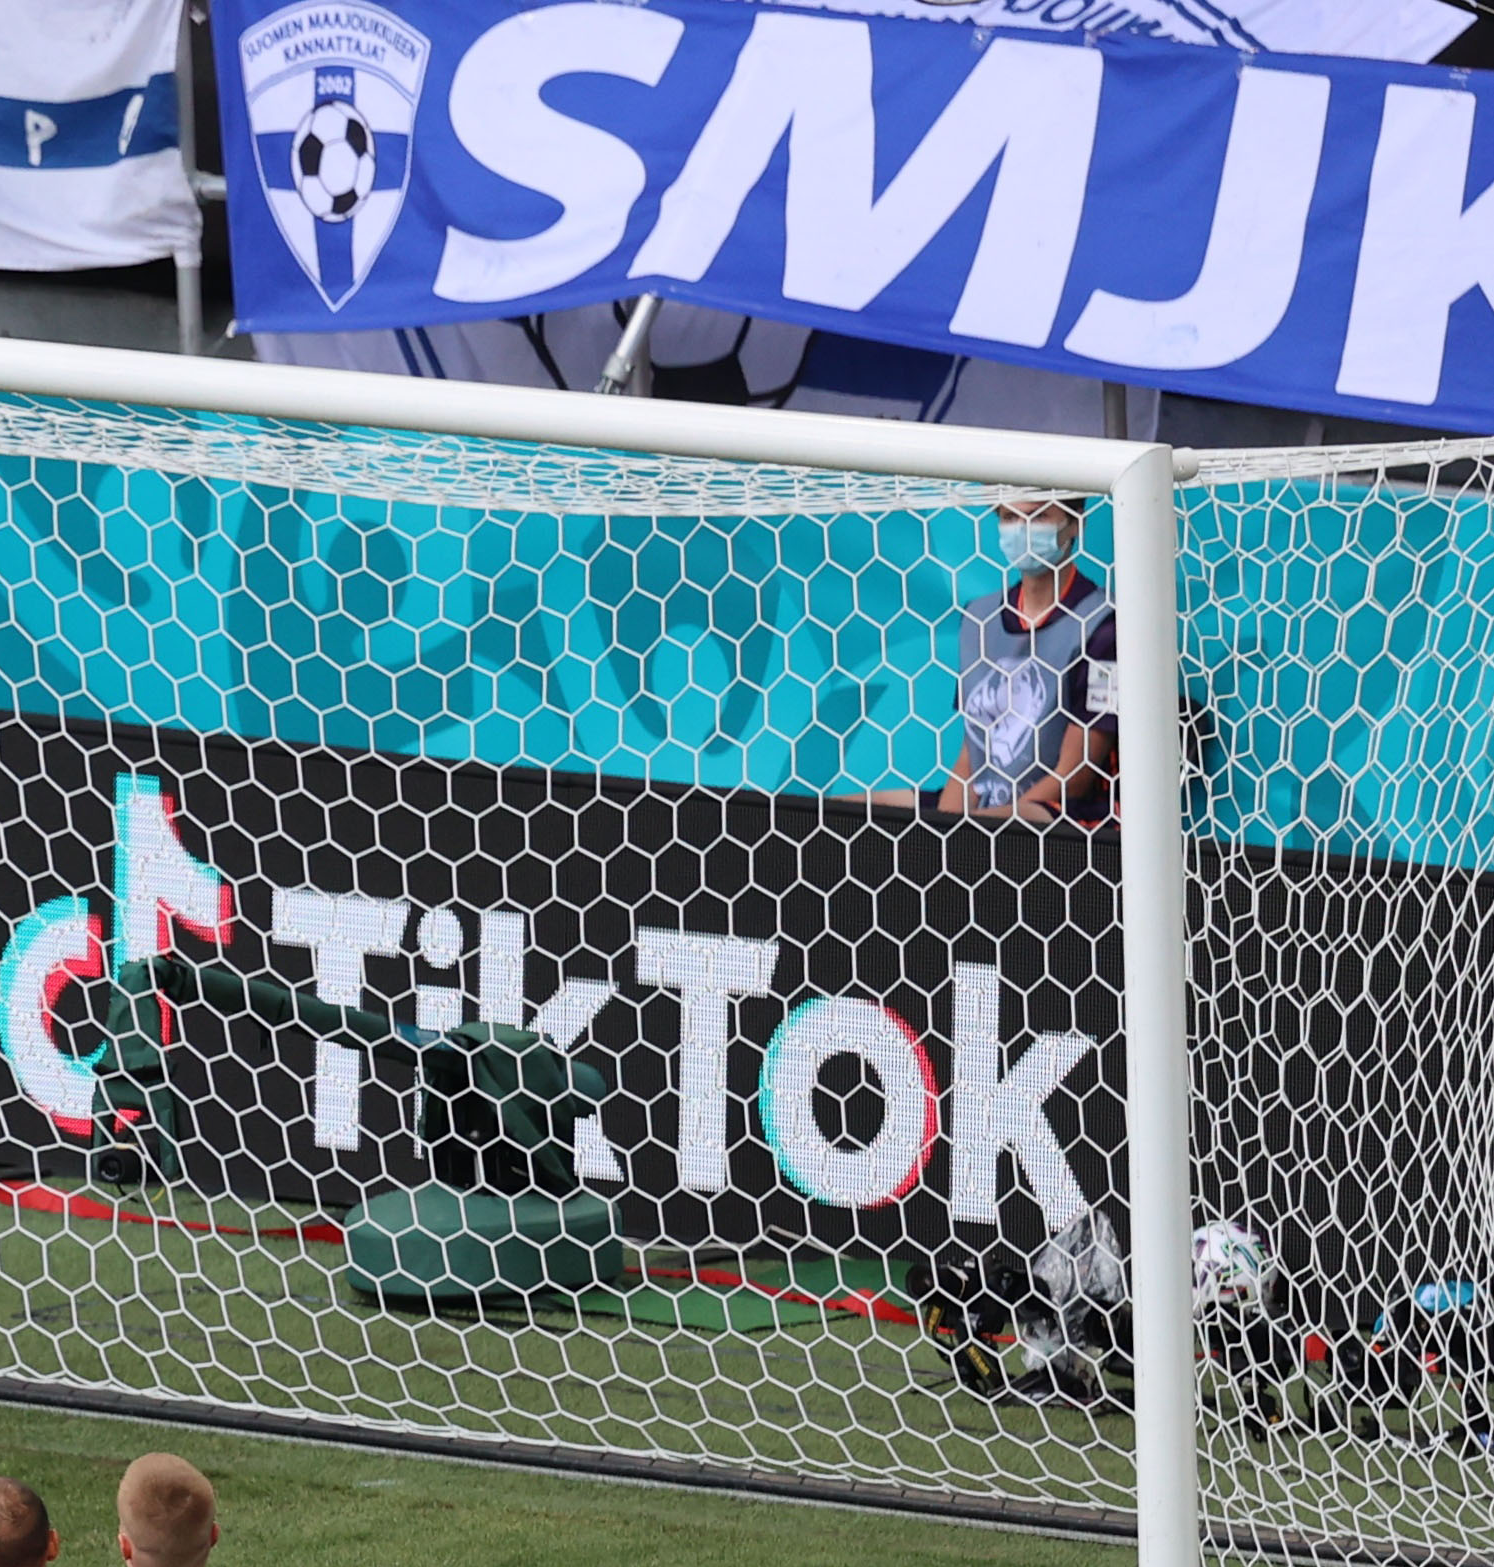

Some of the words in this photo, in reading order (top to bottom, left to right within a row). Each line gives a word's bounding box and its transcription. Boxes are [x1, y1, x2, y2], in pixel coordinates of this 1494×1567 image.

[244, 18, 304, 62] SUOMEN
[283, 36, 387, 63] KANNATTAJAT
[431, 1, 1494, 406] SMJK
